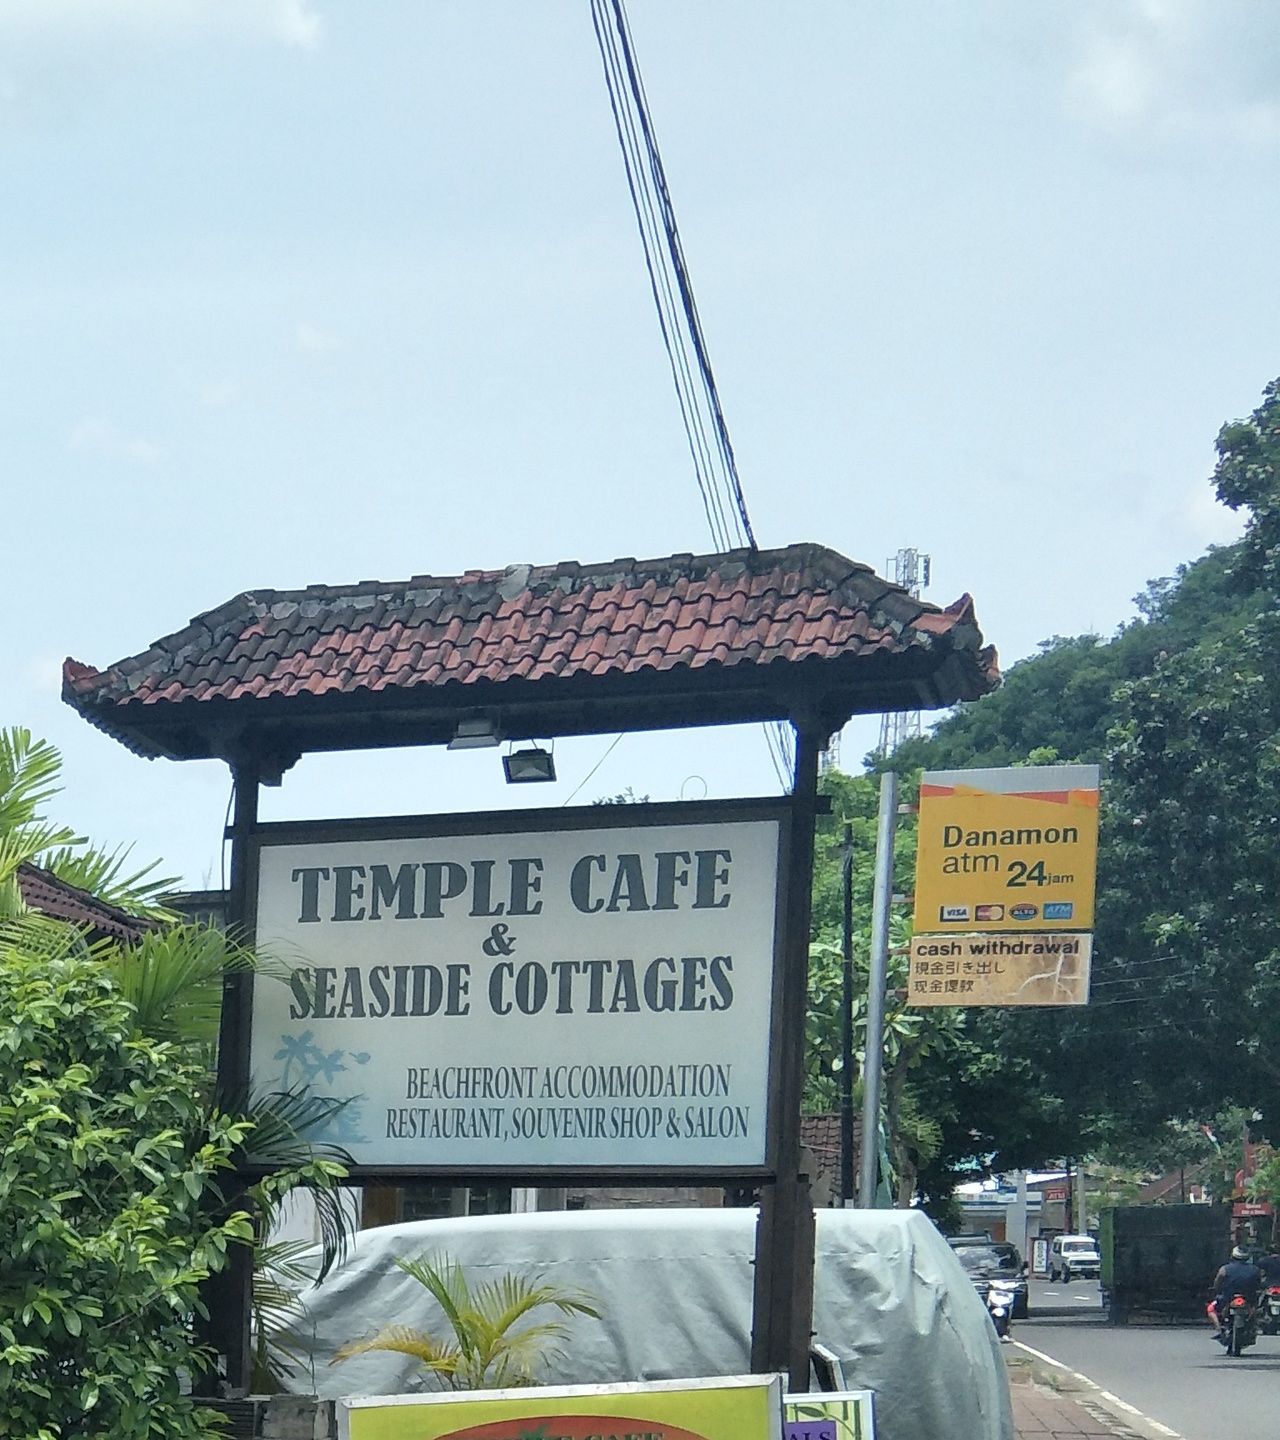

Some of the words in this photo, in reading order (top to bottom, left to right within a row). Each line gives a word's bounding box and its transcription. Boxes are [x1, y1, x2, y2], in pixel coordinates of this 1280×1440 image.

[943, 826, 1079, 848] Danamon
[291, 857, 544, 923] TEMPLE
[570, 849, 733, 915] CAFE
[942, 852, 1000, 874] atm
[1006, 861, 1048, 887] 24
[1048, 871, 1075, 886] jam
[947, 907, 967, 916] VISA
[482, 923, 517, 957] &
[917, 942, 962, 956] cash
[969, 940, 1080, 955] withdrawal
[289, 963, 471, 1020] SEASIDE
[488, 955, 735, 1016] COTTAGES
[406, 1066, 539, 1100] BEACHFRONT
[541, 1064, 732, 1099] ACCOMMODATION
[386, 1108, 508, 1143] RESTAURANT,
[510, 1107, 609, 1138] SOUVENIR
[610, 1107, 662, 1138] SHOP
[666, 1107, 681, 1138] &
[684, 1105, 750, 1138] SALON
